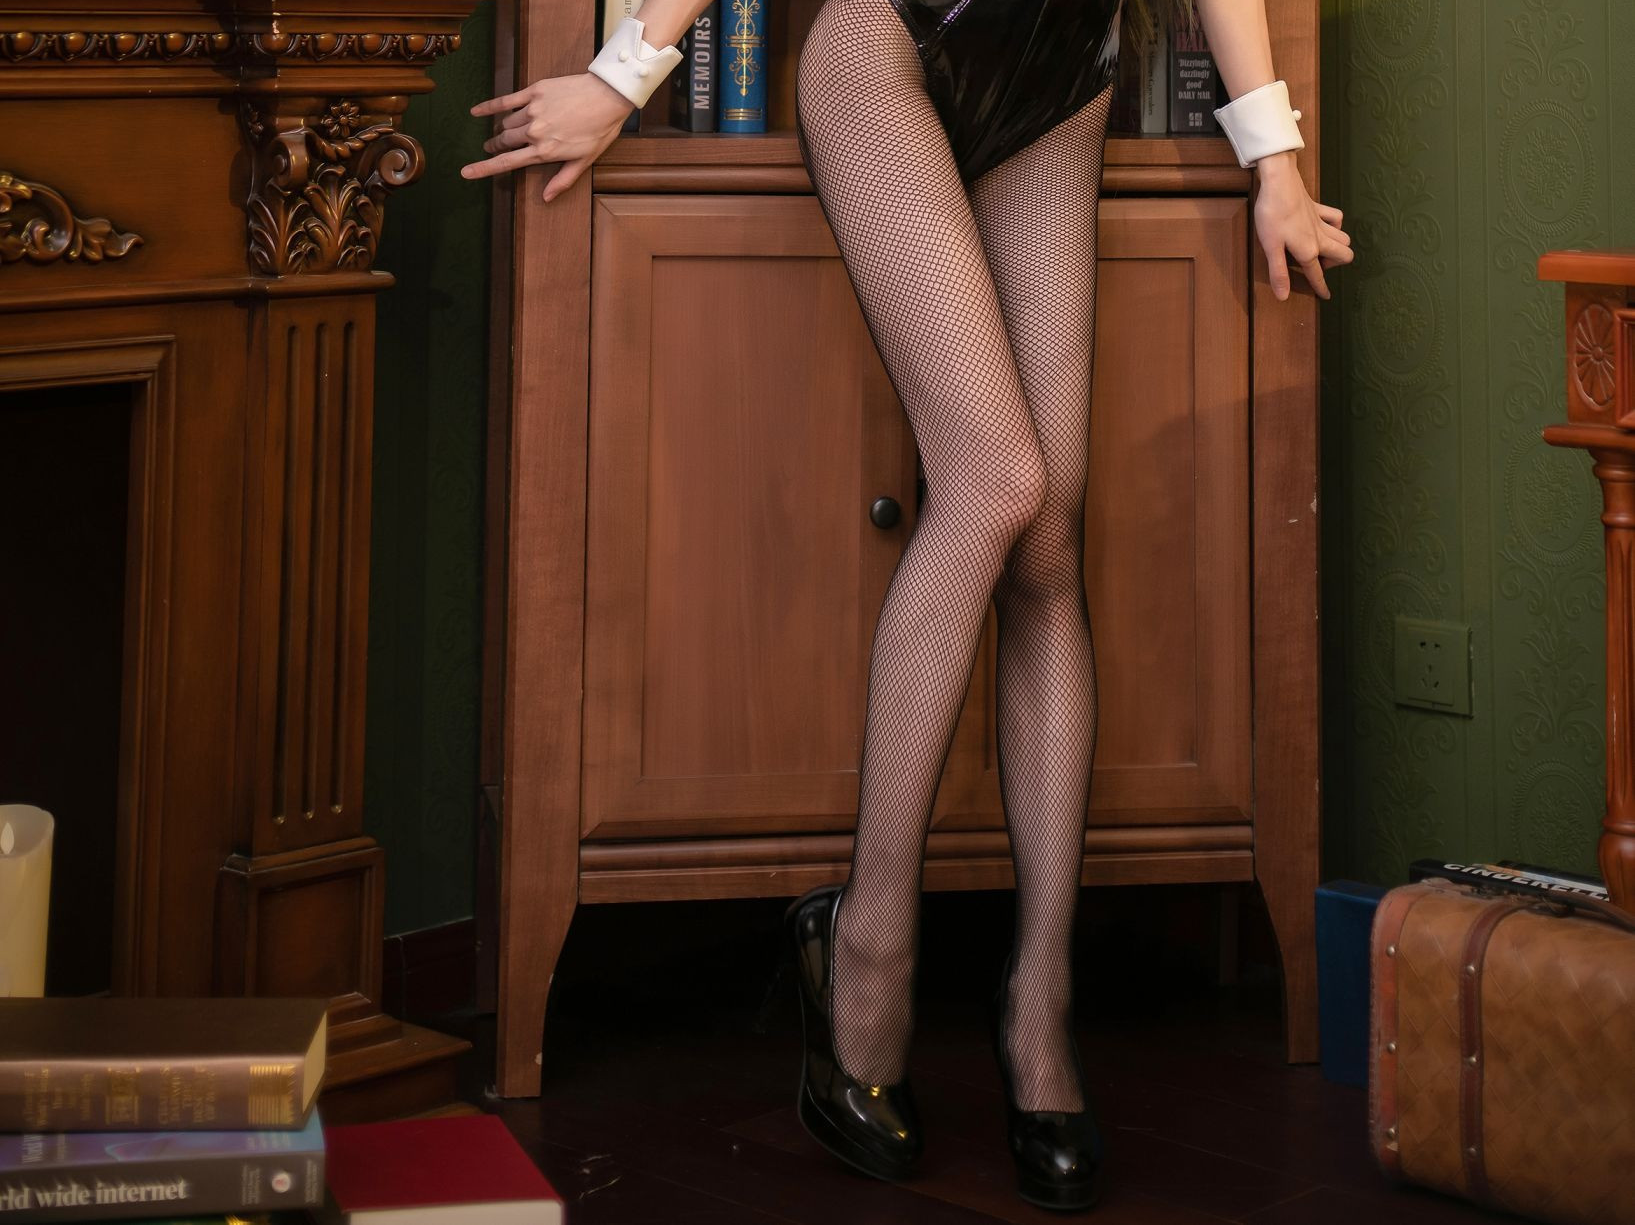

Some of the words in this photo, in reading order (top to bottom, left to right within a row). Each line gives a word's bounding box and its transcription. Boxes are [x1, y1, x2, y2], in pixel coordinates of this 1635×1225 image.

[693, 16, 711, 110] MEMOIRS
[1180, 70, 1210, 80] dazzlingly
[1178, 91, 1197, 100] DAILY
[37, 1181, 90, 1208] wide
[96, 1177, 188, 1206] internet
